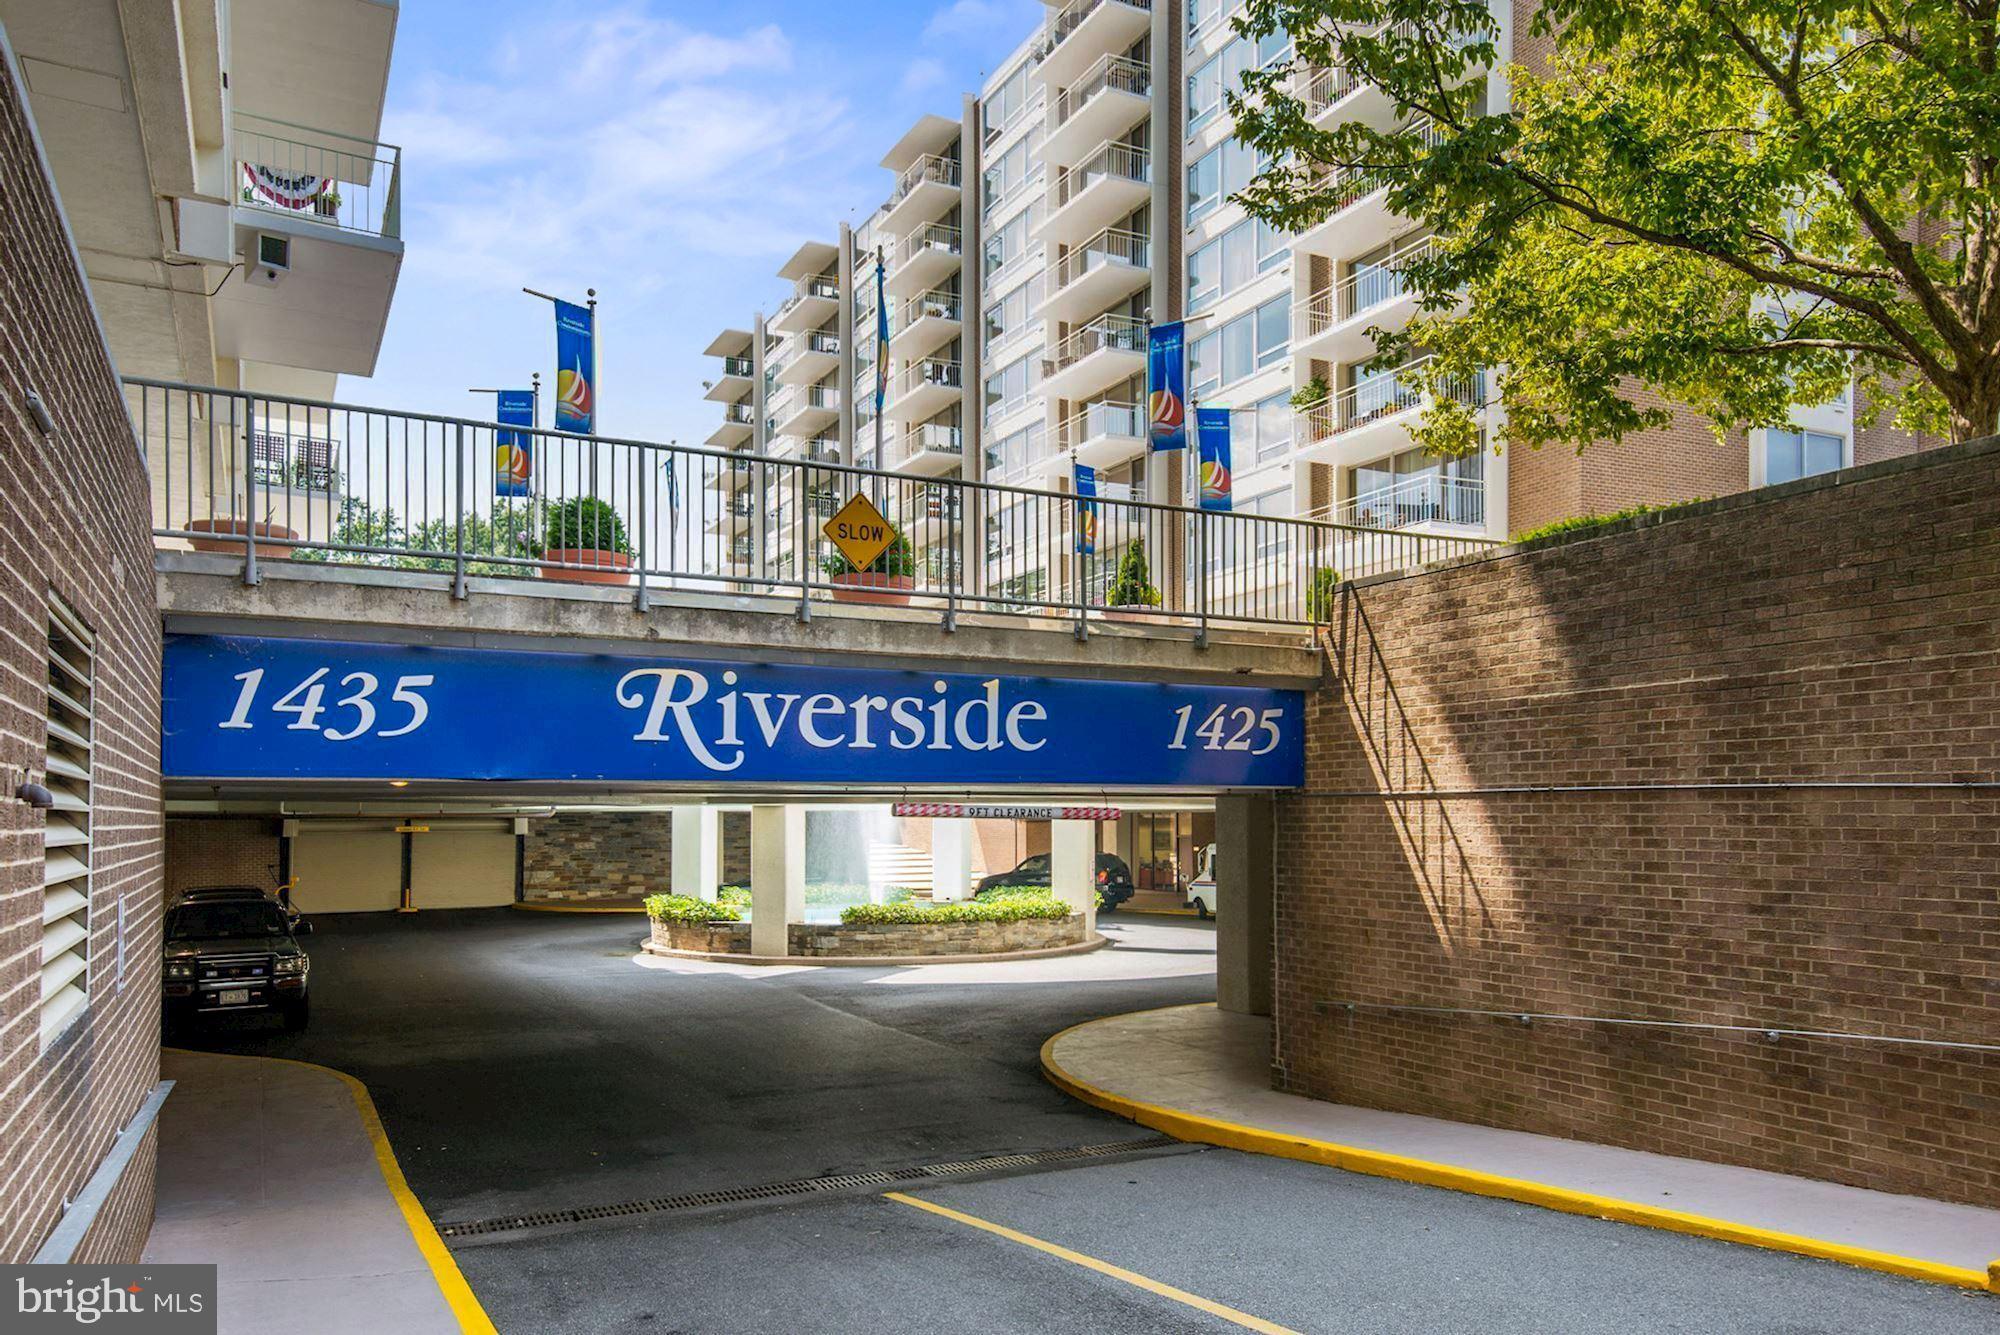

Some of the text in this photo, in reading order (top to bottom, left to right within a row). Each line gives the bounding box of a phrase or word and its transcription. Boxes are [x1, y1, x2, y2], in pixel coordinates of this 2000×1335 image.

[838, 523, 884, 542] SLOW
[218, 667, 1284, 771] 1435 Riverside 1425
[968, 807, 1052, 818] 9FT CLEARANCE
